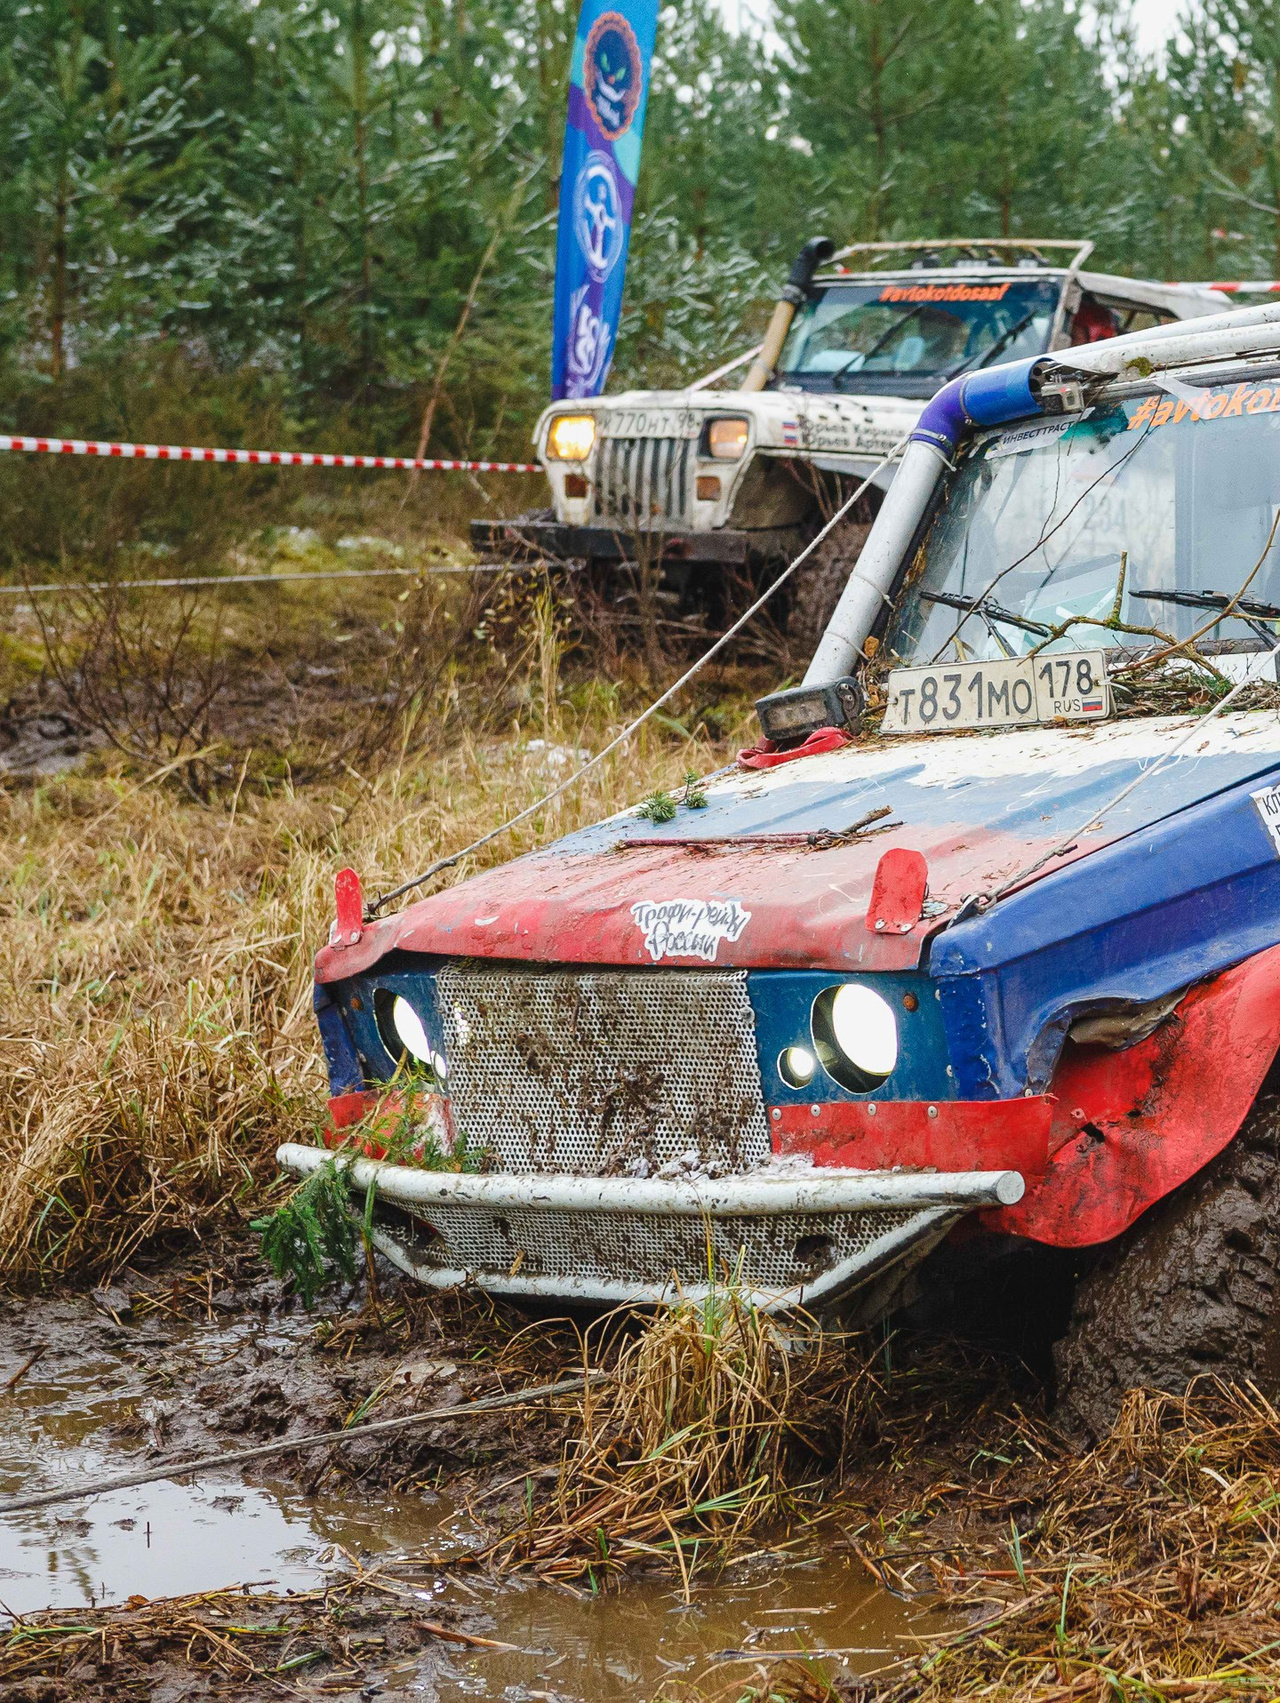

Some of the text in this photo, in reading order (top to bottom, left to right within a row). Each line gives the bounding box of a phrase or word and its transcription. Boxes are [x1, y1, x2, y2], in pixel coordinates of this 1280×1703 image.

[899, 659, 1095, 725] Т831МО 178
[1054, 699, 1081, 713] RUS
[648, 921, 716, 956] России
